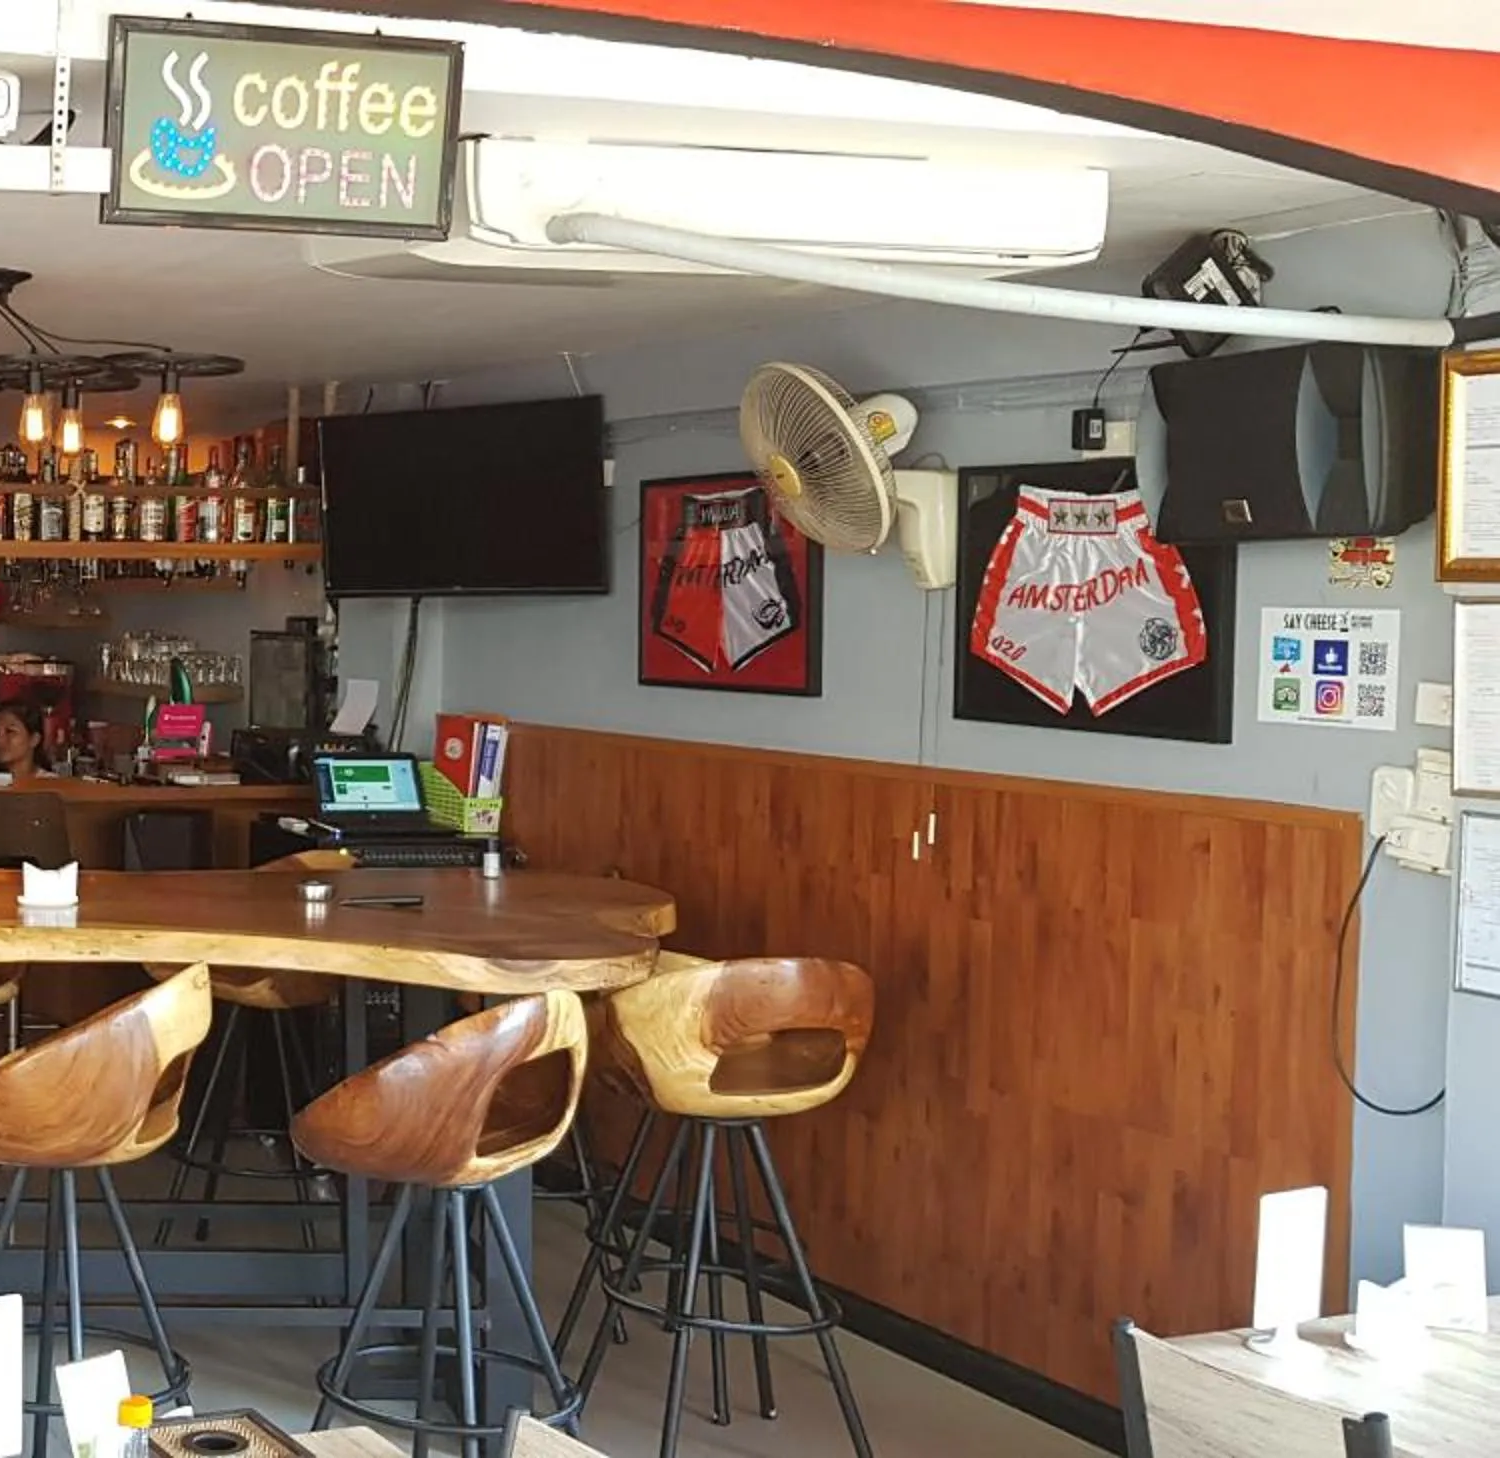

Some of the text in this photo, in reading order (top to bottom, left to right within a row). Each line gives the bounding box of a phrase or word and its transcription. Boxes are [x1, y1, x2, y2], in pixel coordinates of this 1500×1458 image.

[233, 60, 437, 137] coffee
[250, 144, 416, 209] OPEN
[1283, 612, 1337, 631] SAY CHEESE
